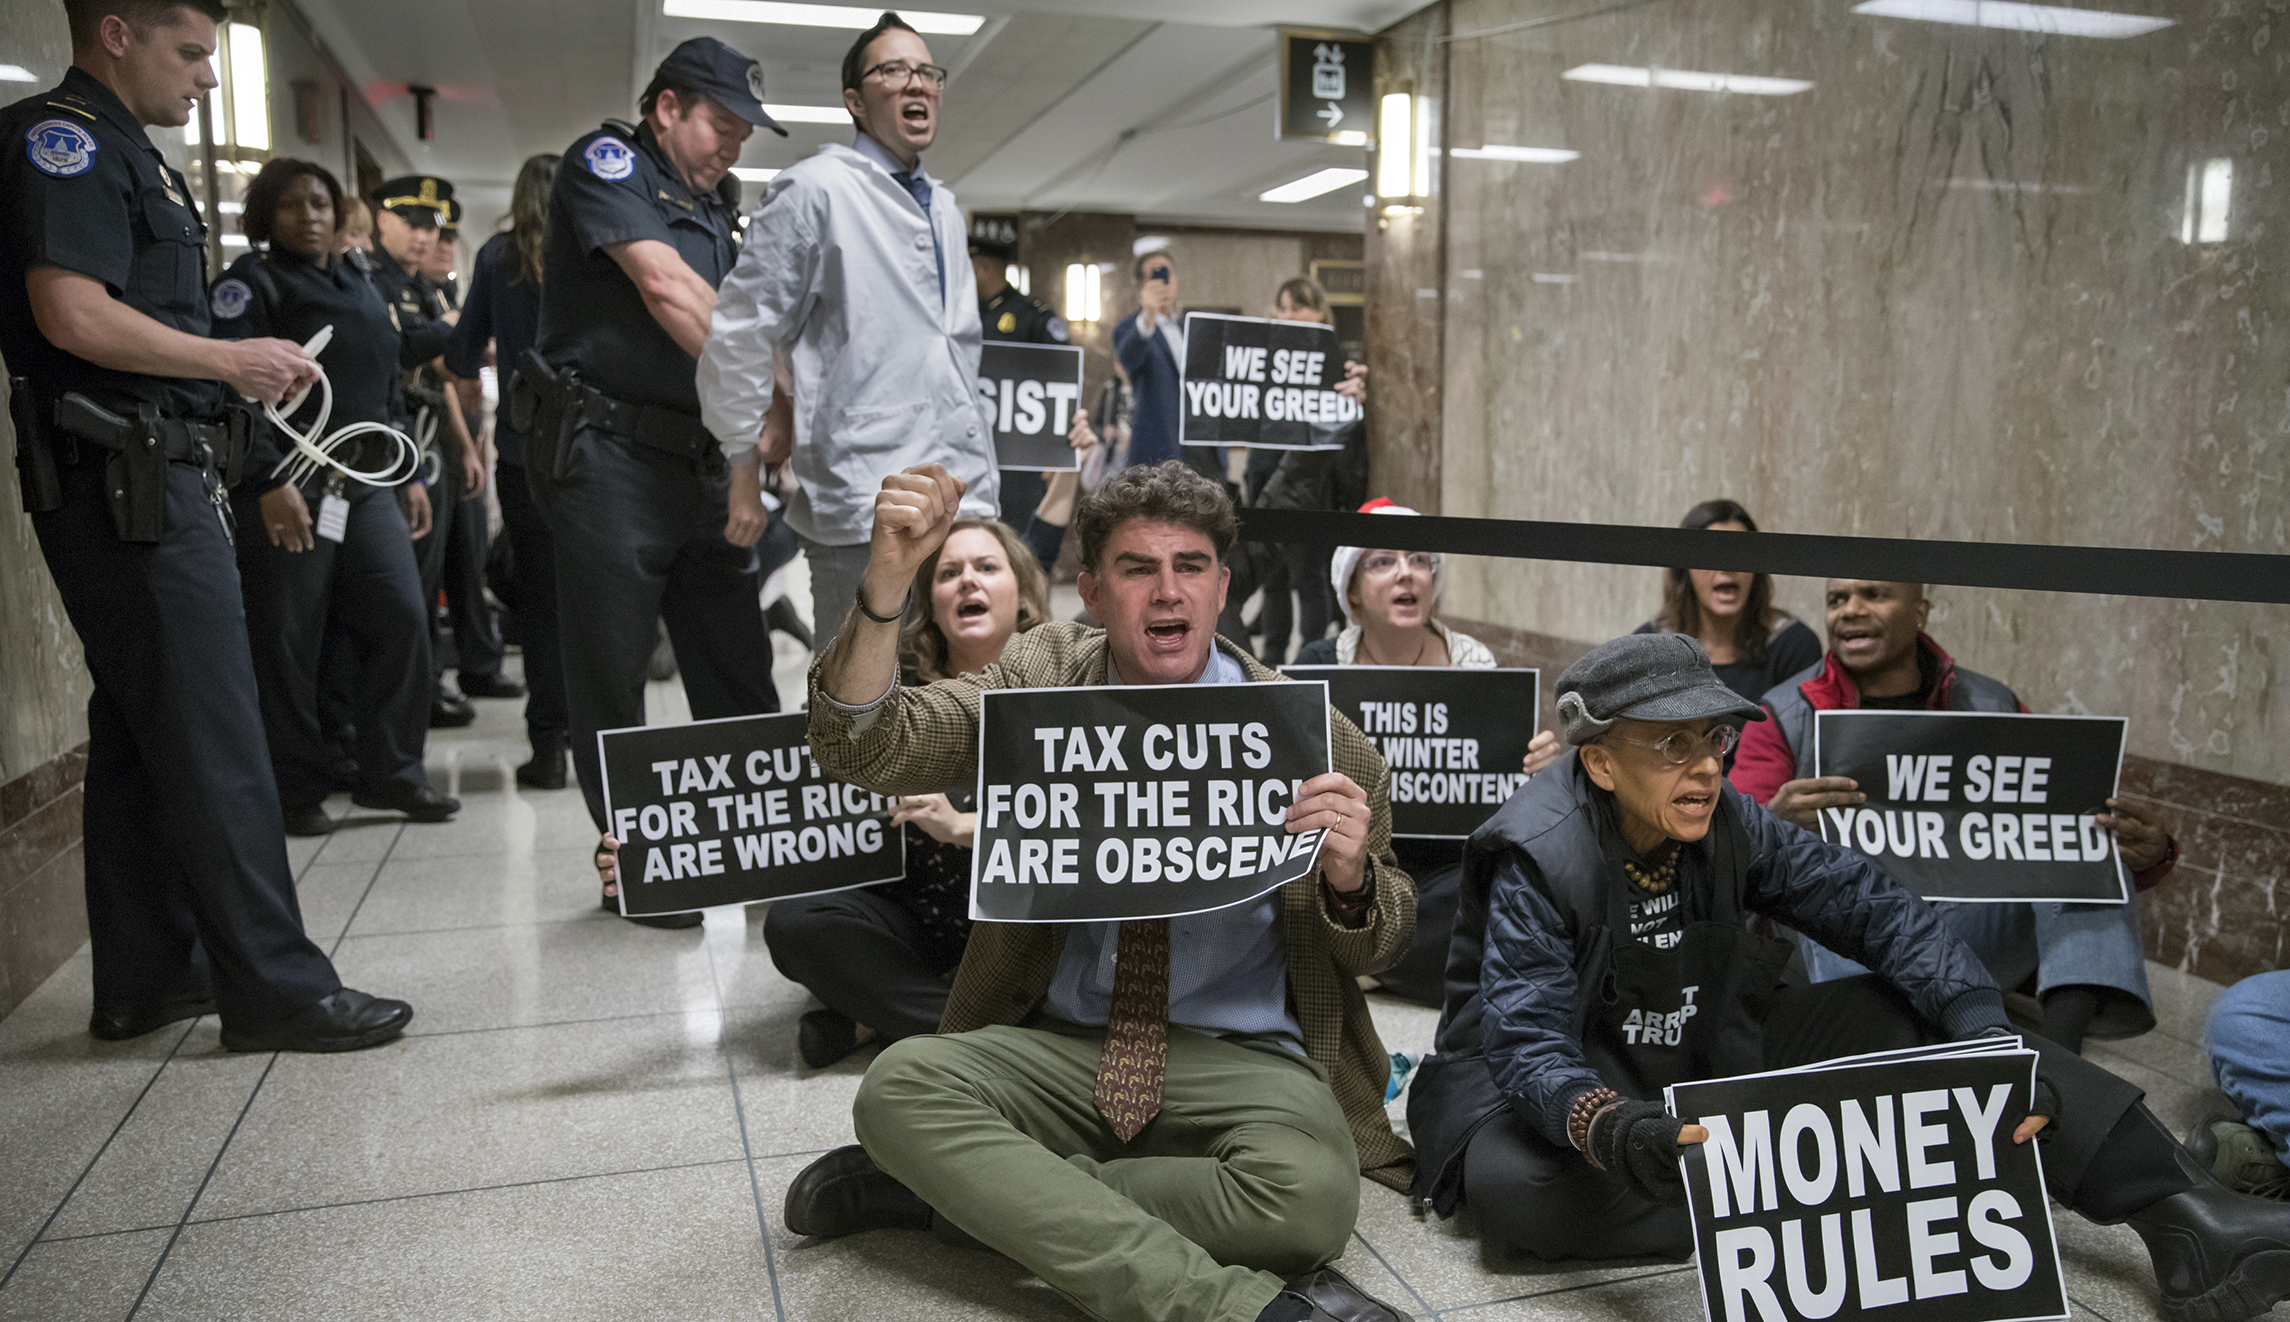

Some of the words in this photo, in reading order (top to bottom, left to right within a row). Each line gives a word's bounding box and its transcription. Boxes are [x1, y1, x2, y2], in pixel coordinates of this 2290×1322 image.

[1225, 345, 1268, 382] WE
[1271, 348, 1326, 386] SEE
[978, 377, 1077, 435] SIST
[1186, 381, 1260, 420] YOUR
[1360, 701, 1418, 735] THIS
[1424, 702, 1449, 735] IS
[651, 753, 736, 797] TAX
[745, 745, 822, 786] CUT
[1034, 725, 1129, 773] TAX
[1142, 722, 1272, 771] CUTS
[1382, 737, 1480, 770] WINTER
[986, 783, 1081, 829] FOR
[1094, 780, 1191, 828] THE
[1208, 778, 1303, 827] RIC
[1387, 772, 1532, 804] ISCONTENT
[1886, 754, 1954, 802] WE
[1963, 754, 2053, 804] SEE
[615, 800, 700, 845] FOR
[707, 788, 792, 832] THE
[1825, 807, 1950, 859] YOUR
[1959, 811, 2110, 863] GREED
[643, 839, 726, 884] ARE
[733, 819, 884, 871] WRONG
[982, 838, 1080, 885] ARE
[1095, 828, 1320, 885] OBSCENE
[1630, 916, 1668, 935] NOT
[1698, 1082, 2013, 1219] MONEY
[1715, 1188, 2035, 1322] RULES
